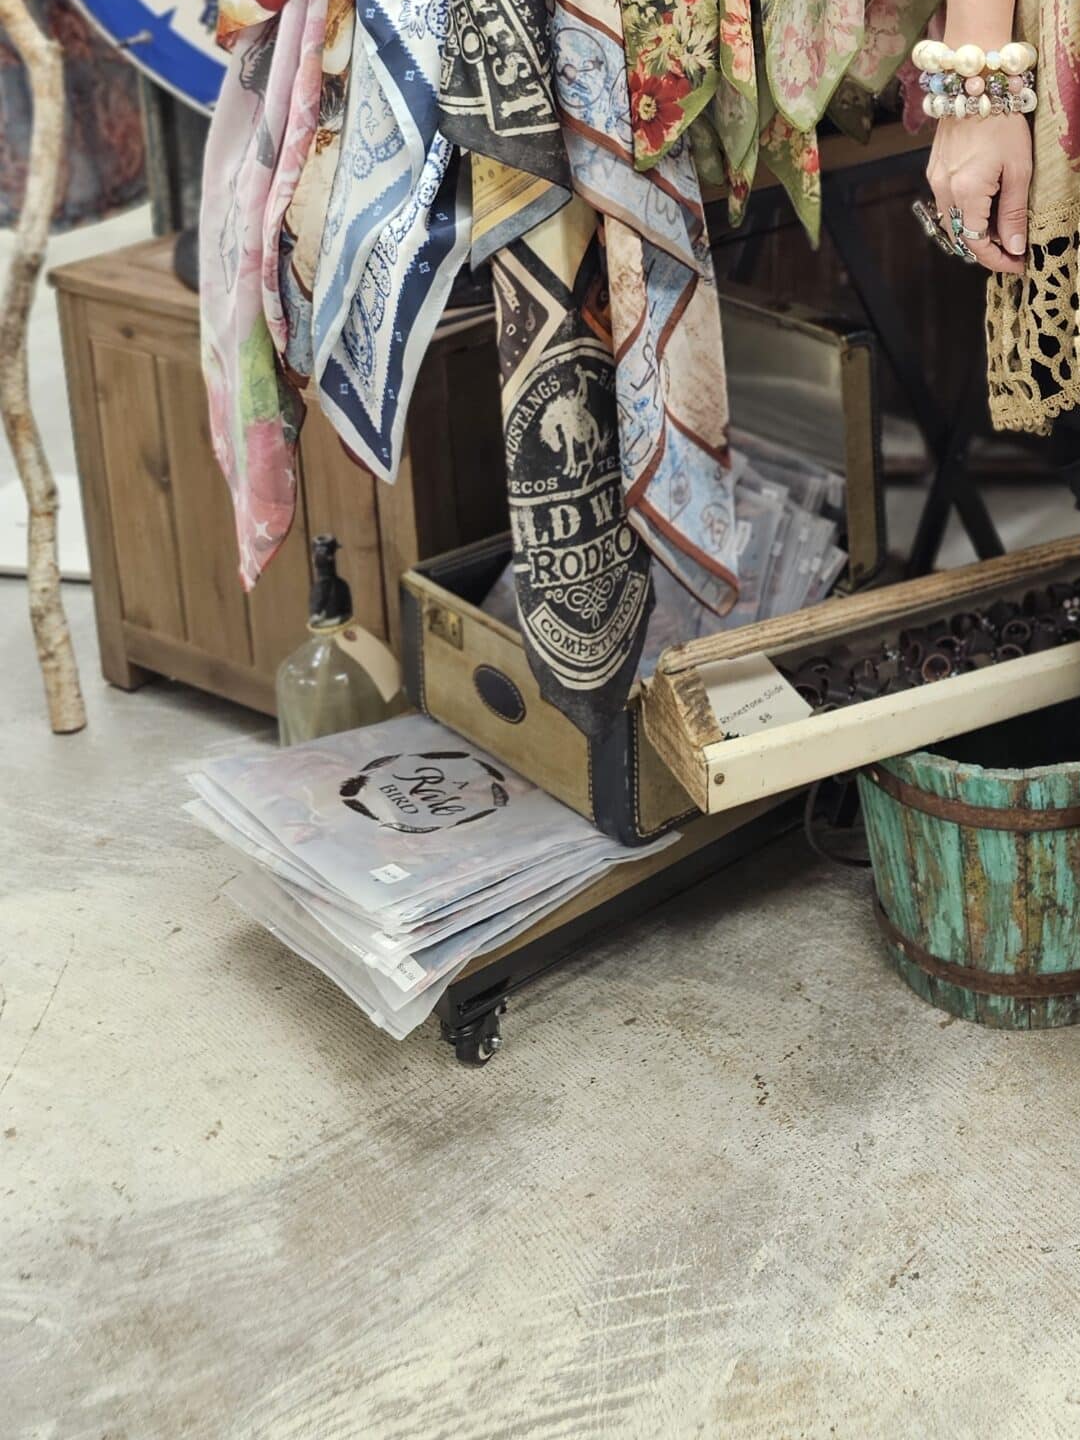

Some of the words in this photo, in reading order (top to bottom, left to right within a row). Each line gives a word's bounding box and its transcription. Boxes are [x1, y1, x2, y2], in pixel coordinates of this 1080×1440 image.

[508, 477, 559, 494] ECOS
[530, 523, 636, 586] RODEO
[540, 582, 640, 657] COMPETITION
[379, 784, 419, 814] BIRD
